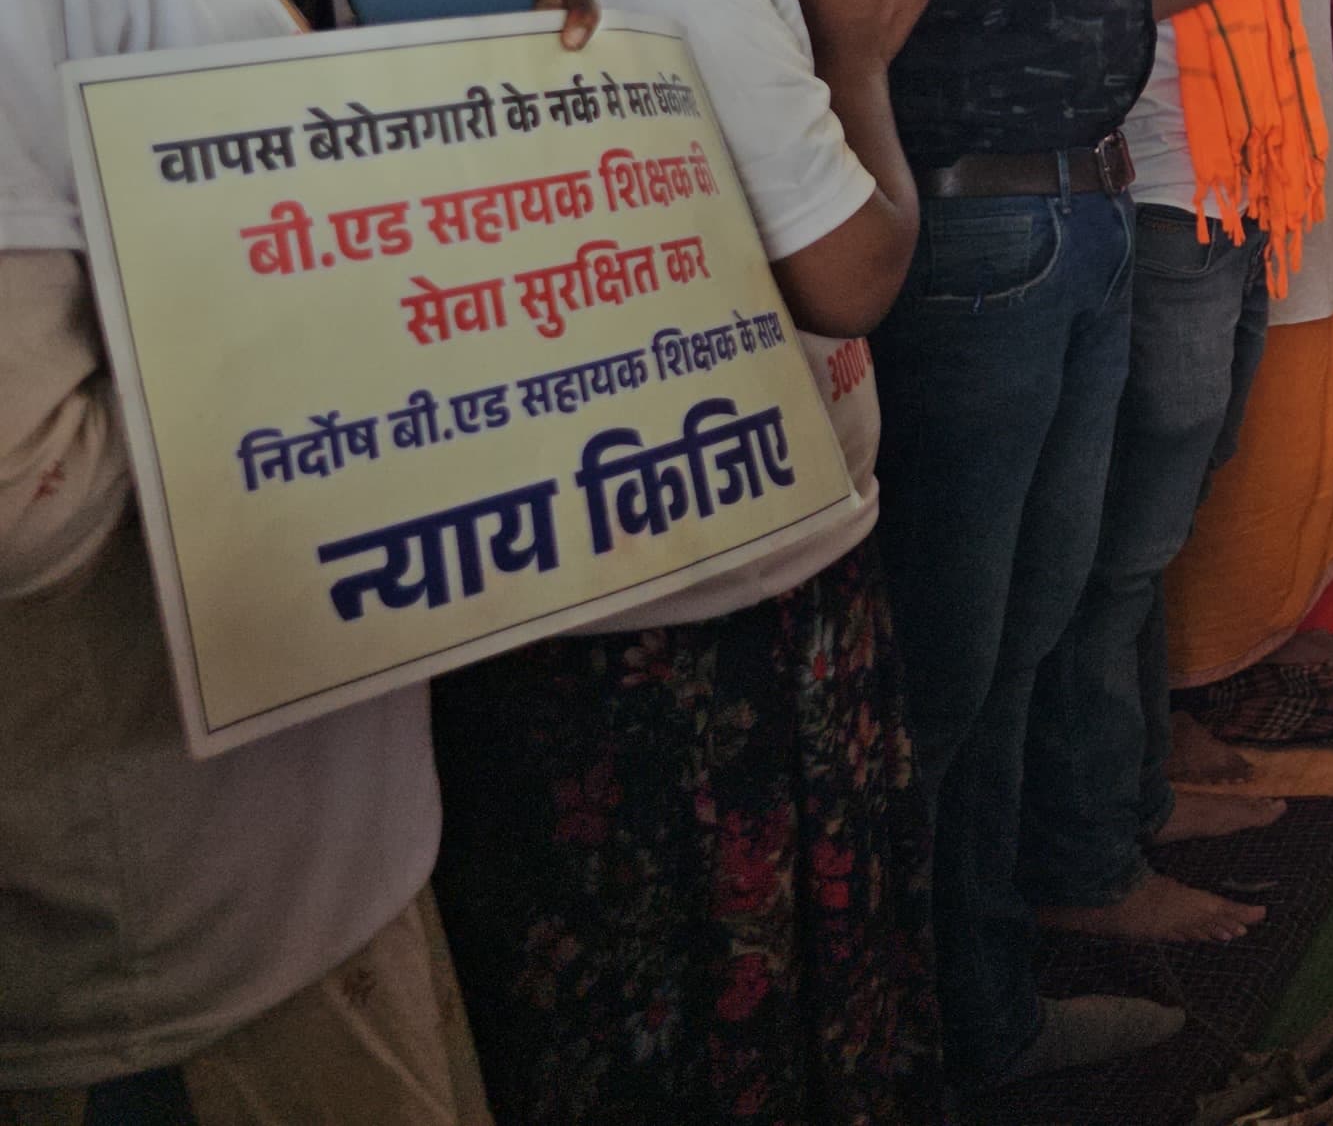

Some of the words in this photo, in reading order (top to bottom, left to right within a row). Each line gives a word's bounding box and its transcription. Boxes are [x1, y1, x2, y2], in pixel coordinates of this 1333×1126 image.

[152, 126, 297, 184] वापस
[302, 85, 498, 162] बेरोजगारी
[502, 82, 541, 133] के
[543, 73, 601, 127] नर्क
[623, 81, 657, 117] मत
[239, 199, 413, 276] बी.एड
[420, 169, 595, 246] सहायक
[597, 147, 695, 212] शिक्षक
[400, 275, 508, 346] सेवा
[514, 239, 661, 339] सुरक्षित
[660, 235, 713, 286] कर
[235, 408, 380, 492] निर्दोष
[387, 384, 512, 449] बी.एड
[516, 348, 649, 418] सहायक
[651, 327, 739, 381] शिक्षक
[732, 309, 757, 355] के
[752, 311, 787, 351] साथ
[316, 477, 562, 623] न्याय
[573, 397, 798, 556] किजिए
